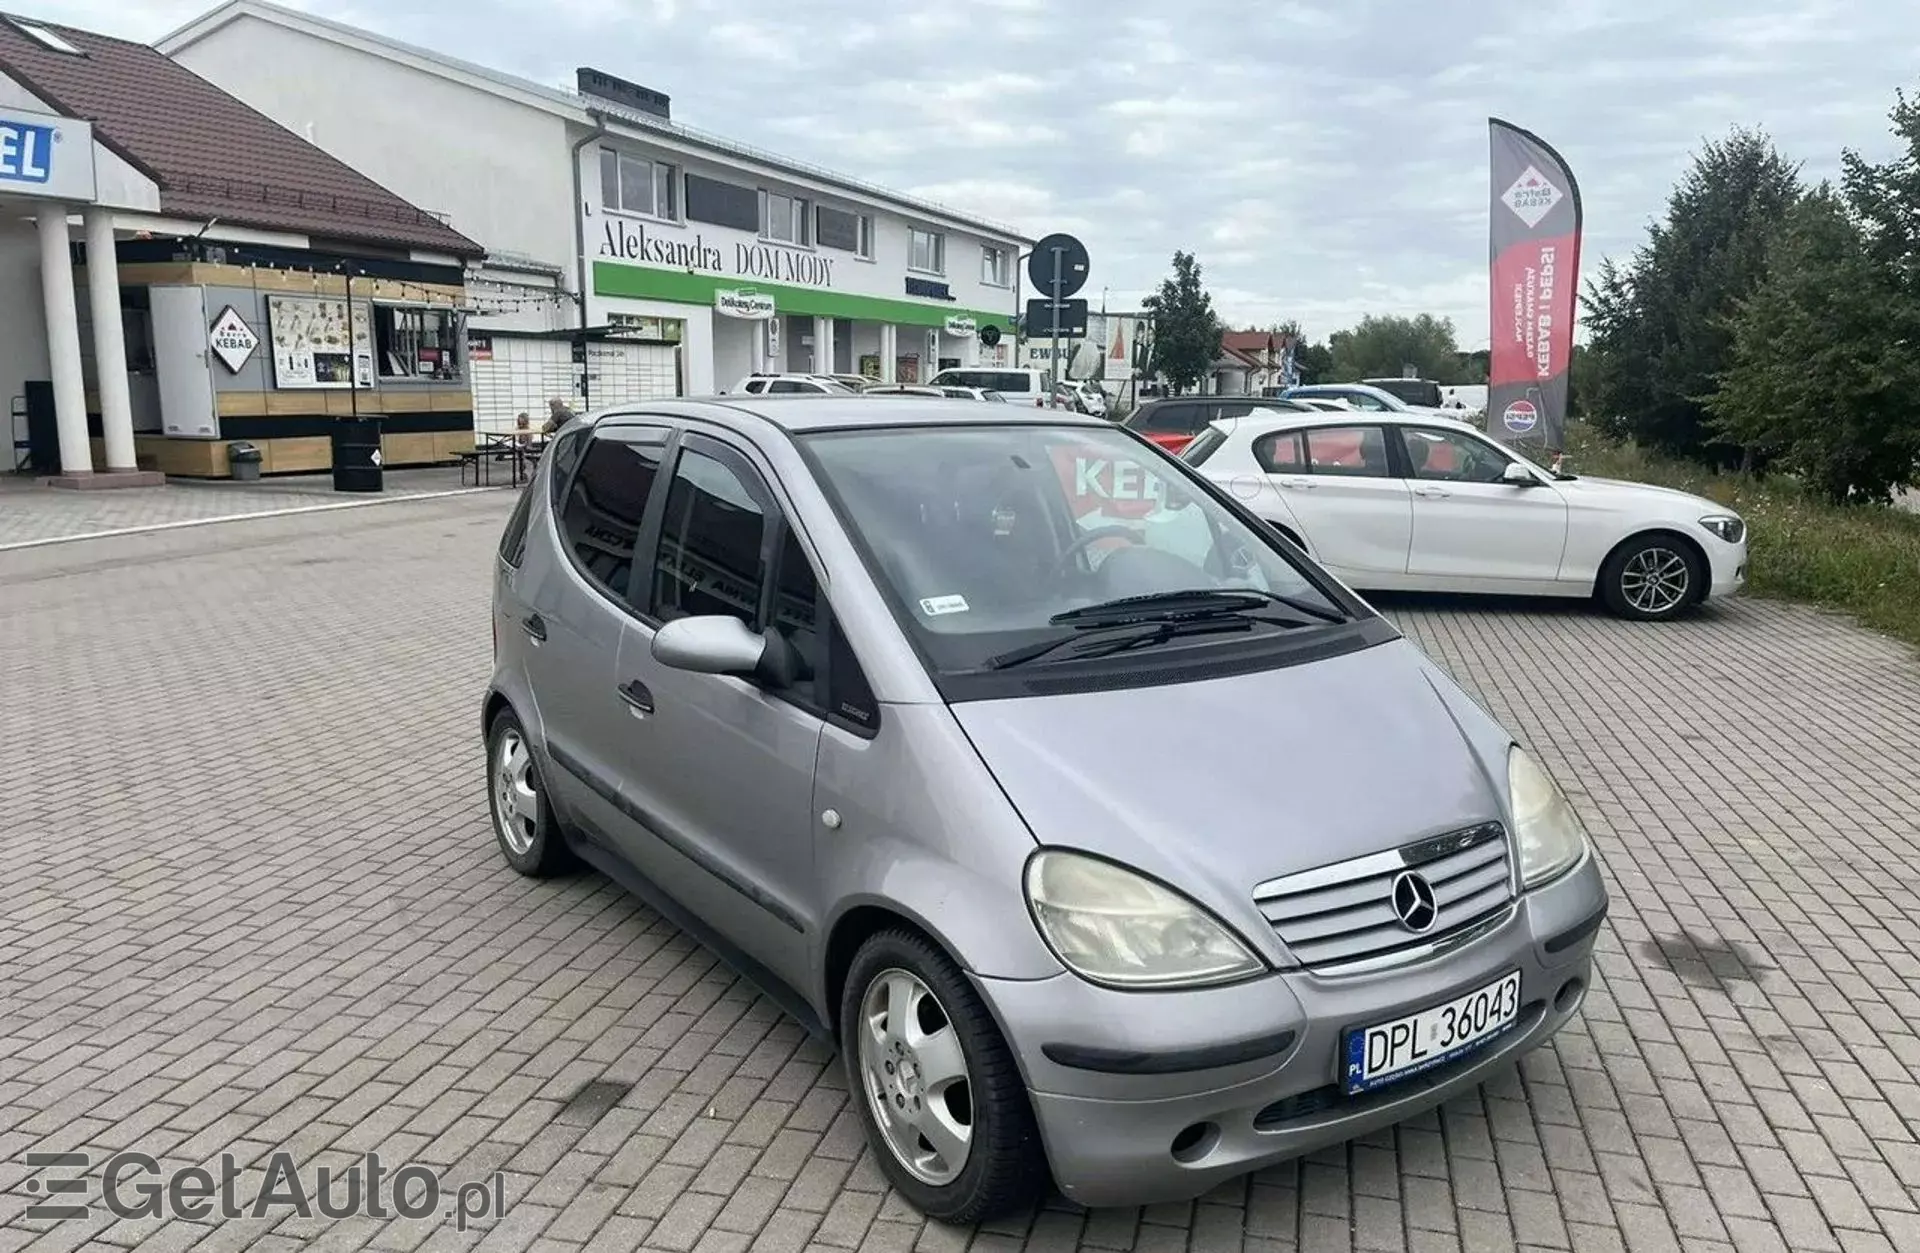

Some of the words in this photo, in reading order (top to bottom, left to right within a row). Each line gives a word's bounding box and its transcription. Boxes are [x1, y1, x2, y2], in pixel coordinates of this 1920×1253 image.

[600, 219, 722, 271] Aleksandra
[736, 242, 780, 280] DOM
[786, 251, 833, 287] MODY
[215, 338, 252, 349] KEBAB
[1368, 1019, 1427, 1074] DPL
[1440, 979, 1517, 1047] 36043
[1350, 1063, 1362, 1077] PL
